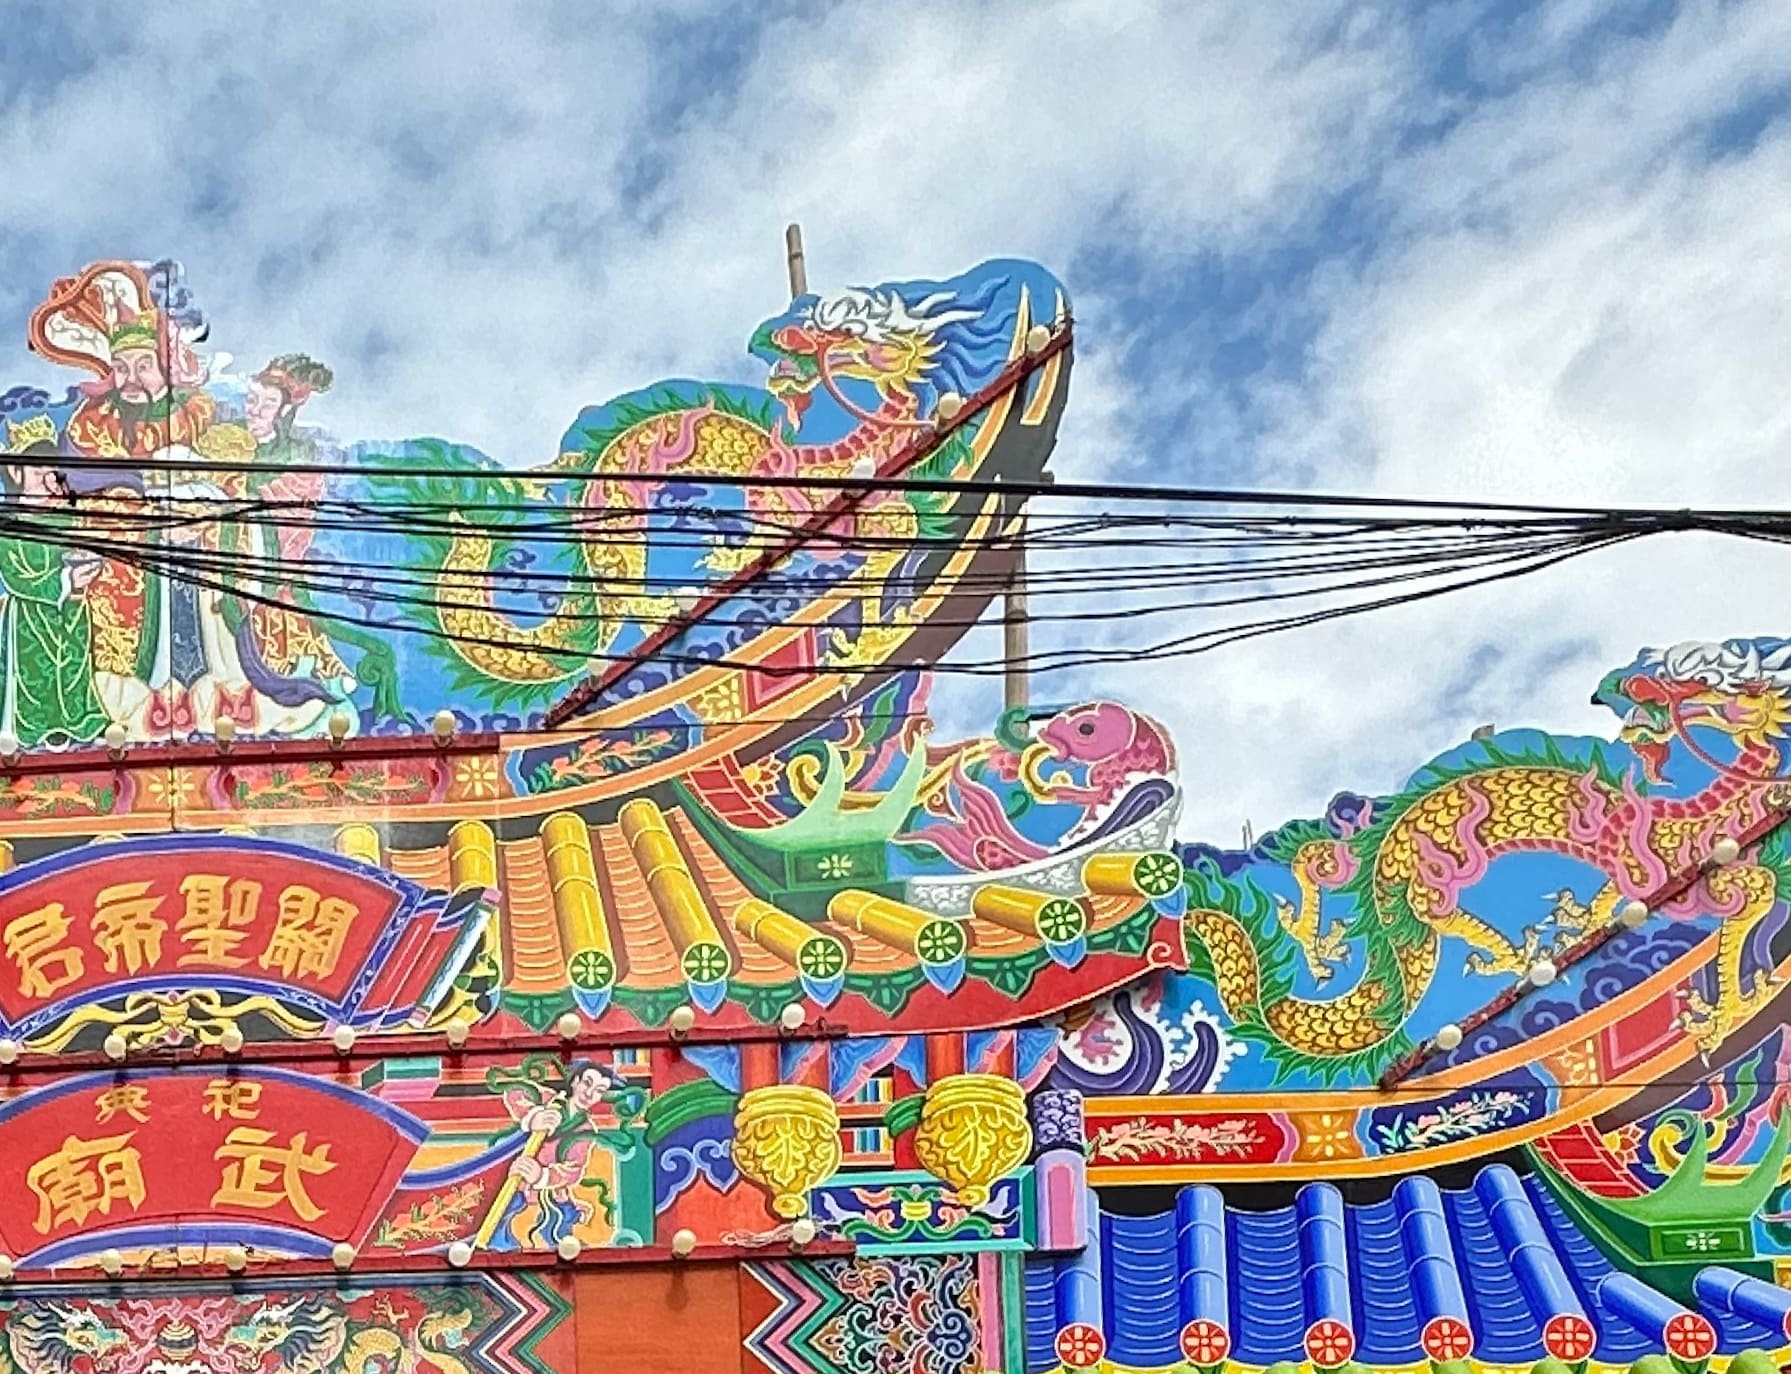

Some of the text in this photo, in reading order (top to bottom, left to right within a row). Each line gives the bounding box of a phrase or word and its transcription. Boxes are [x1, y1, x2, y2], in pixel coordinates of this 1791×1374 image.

[3, 873, 360, 997] 關聖帝君
[25, 1129, 338, 1235] 武廟
